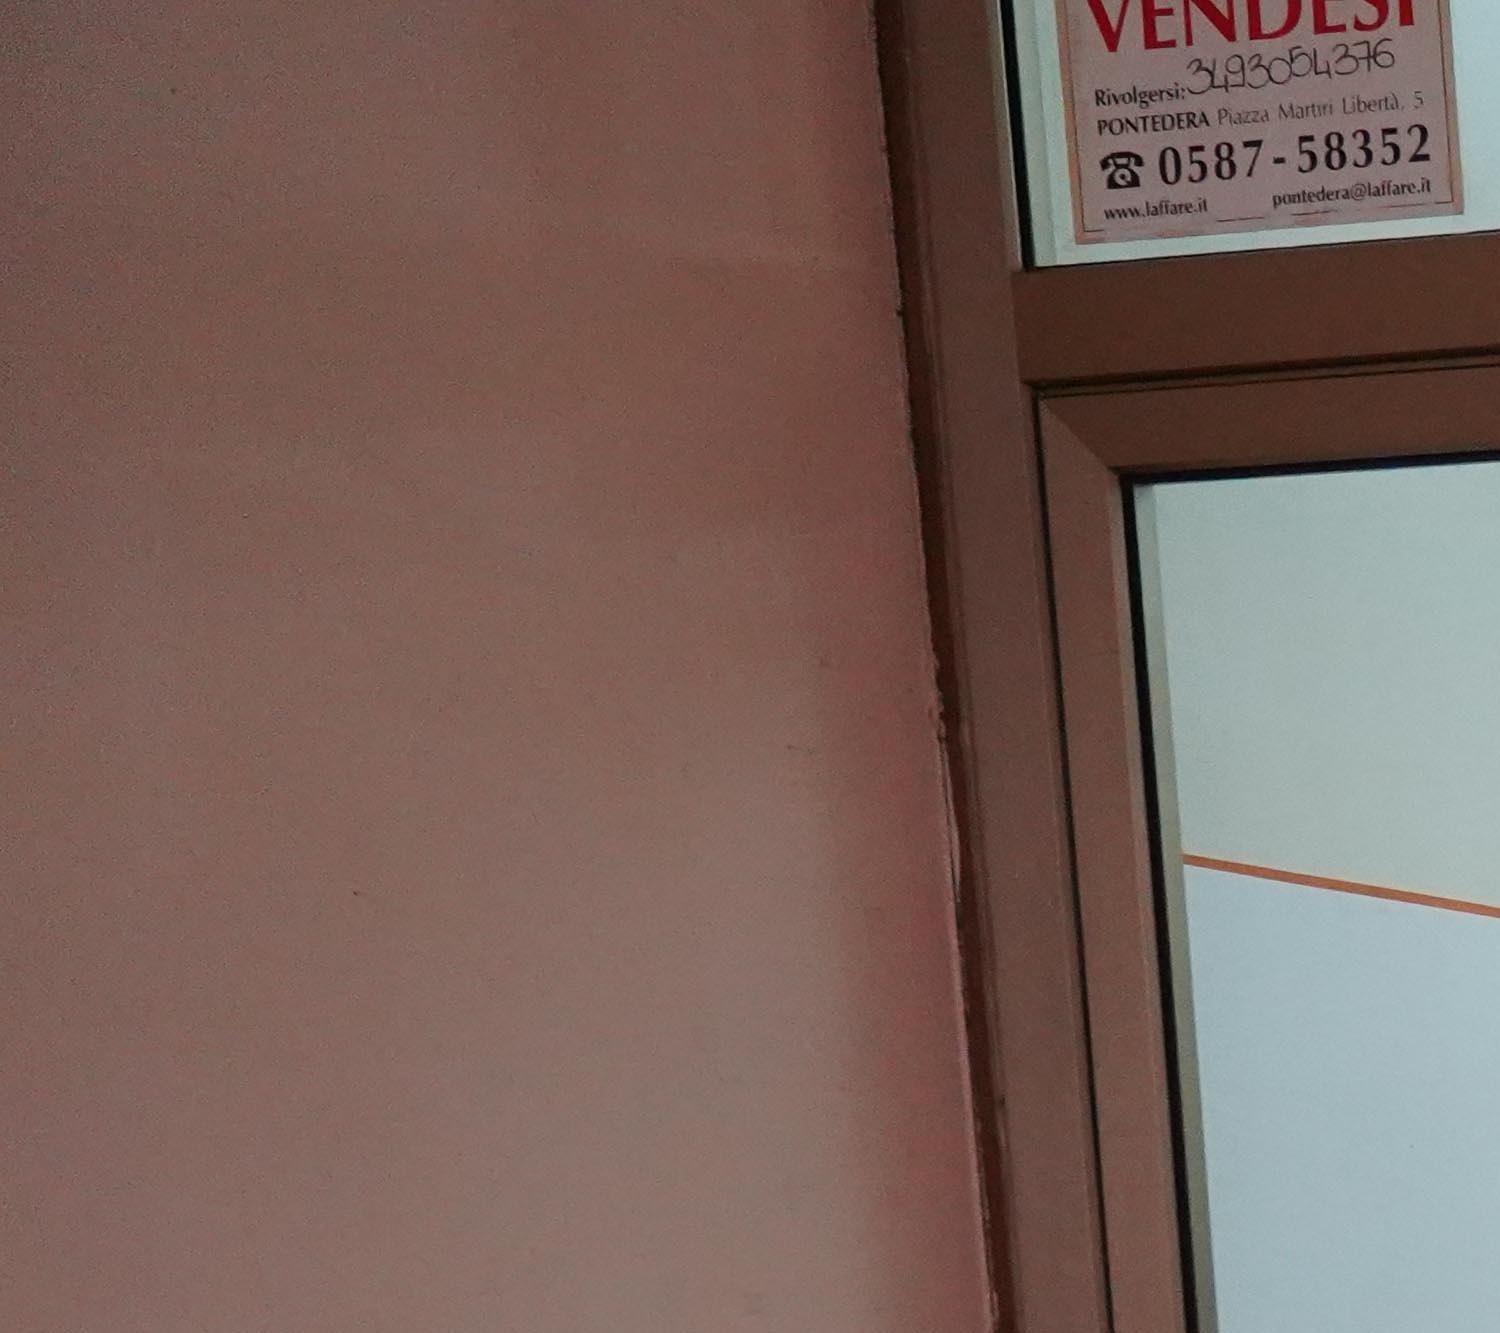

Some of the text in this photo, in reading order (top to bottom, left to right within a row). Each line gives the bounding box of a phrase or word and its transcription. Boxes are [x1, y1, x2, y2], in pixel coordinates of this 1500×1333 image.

[1186, 38, 1396, 95] 3493054376
[1095, 82, 1186, 109] Rivolgersi:
[1097, 111, 1210, 136] PONTEDERA
[1217, 107, 1270, 127] Piazza
[1414, 91, 1424, 109] 5
[1103, 198, 1208, 220] www.laffare.it
[1272, 177, 1431, 210] pontedera@laffare.it
